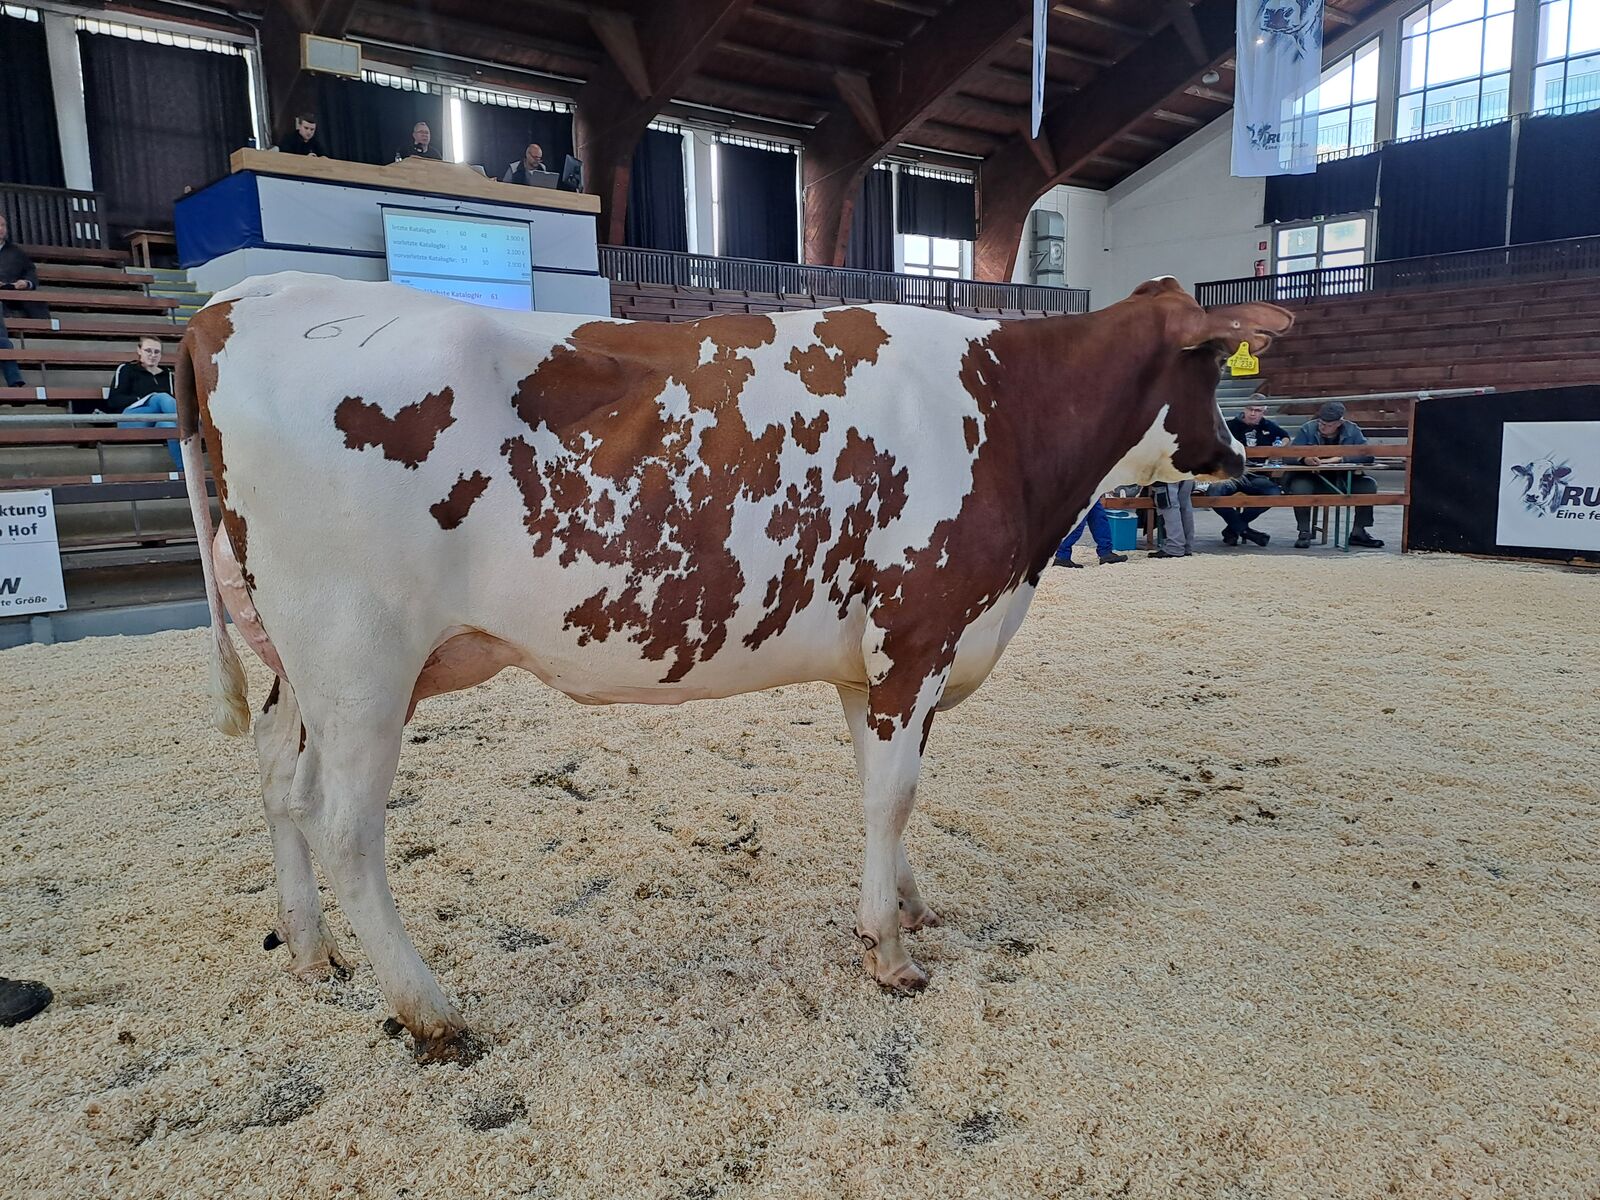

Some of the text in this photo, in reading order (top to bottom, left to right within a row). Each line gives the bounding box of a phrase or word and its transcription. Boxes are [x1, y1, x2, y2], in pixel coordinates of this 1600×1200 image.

[1556, 509, 1585, 520] Eine
[9, 523, 38, 537] Hof
[15, 596, 48, 605] Größe
